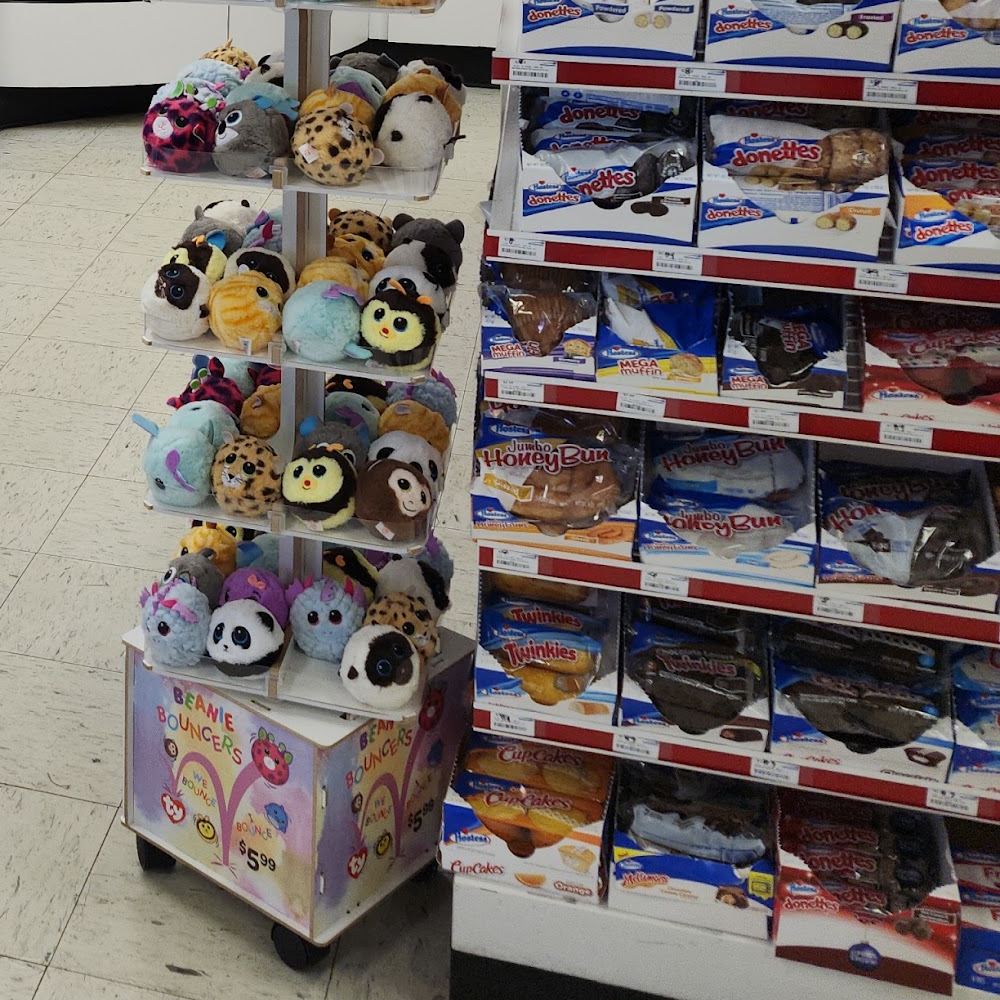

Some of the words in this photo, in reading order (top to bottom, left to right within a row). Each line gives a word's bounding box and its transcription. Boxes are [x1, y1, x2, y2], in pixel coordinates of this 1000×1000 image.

[528, 5, 582, 23] donettes
[594, 3, 628, 14] Powdered
[657, 5, 690, 13] Powdered
[721, 9, 751, 17] Hostess
[857, 14, 886, 22] Frosted
[913, 18, 945, 27] Hostess
[714, 19, 772, 35] donettes
[905, 28, 967, 44] donettes
[558, 106, 640, 124] donettes
[744, 136, 775, 145] Hostess
[731, 141, 822, 168] donettes
[911, 162, 1000, 188] donettes
[532, 183, 560, 191] Hostess
[528, 192, 581, 206] donettes
[705, 207, 764, 221] donettes
[915, 220, 973, 241] donettes
[491, 344, 521, 353] MEGA
[491, 351, 526, 359] muffin
[606, 349, 637, 358] Hostess
[619, 359, 658, 369] MEGA
[620, 367, 663, 376] muffin
[731, 376, 764, 384] MEGA
[877, 390, 921, 401] Hostess
[496, 424, 532, 435] Hostess
[507, 440, 551, 453] Jumbo
[683, 440, 725, 452] Jumbo
[511, 607, 581, 628] Twinkies
[503, 641, 578, 667] Twinkies
[173, 686, 235, 733] BEANIE
[156, 705, 243, 766] BOUNCERS
[359, 719, 395, 751] BEAN
[345, 731, 413, 790] BOUNCERS
[498, 746, 582, 766] CupCakes
[193, 770, 208, 789] WE
[181, 775, 217, 809] BOUNCE
[485, 791, 572, 811] CupCakes
[236, 821, 273, 840] BOUNCE
[453, 832, 488, 844] Hostess
[451, 860, 505, 874] CupCakes
[555, 882, 593, 896] Orange
[784, 896, 840, 912] donettes
